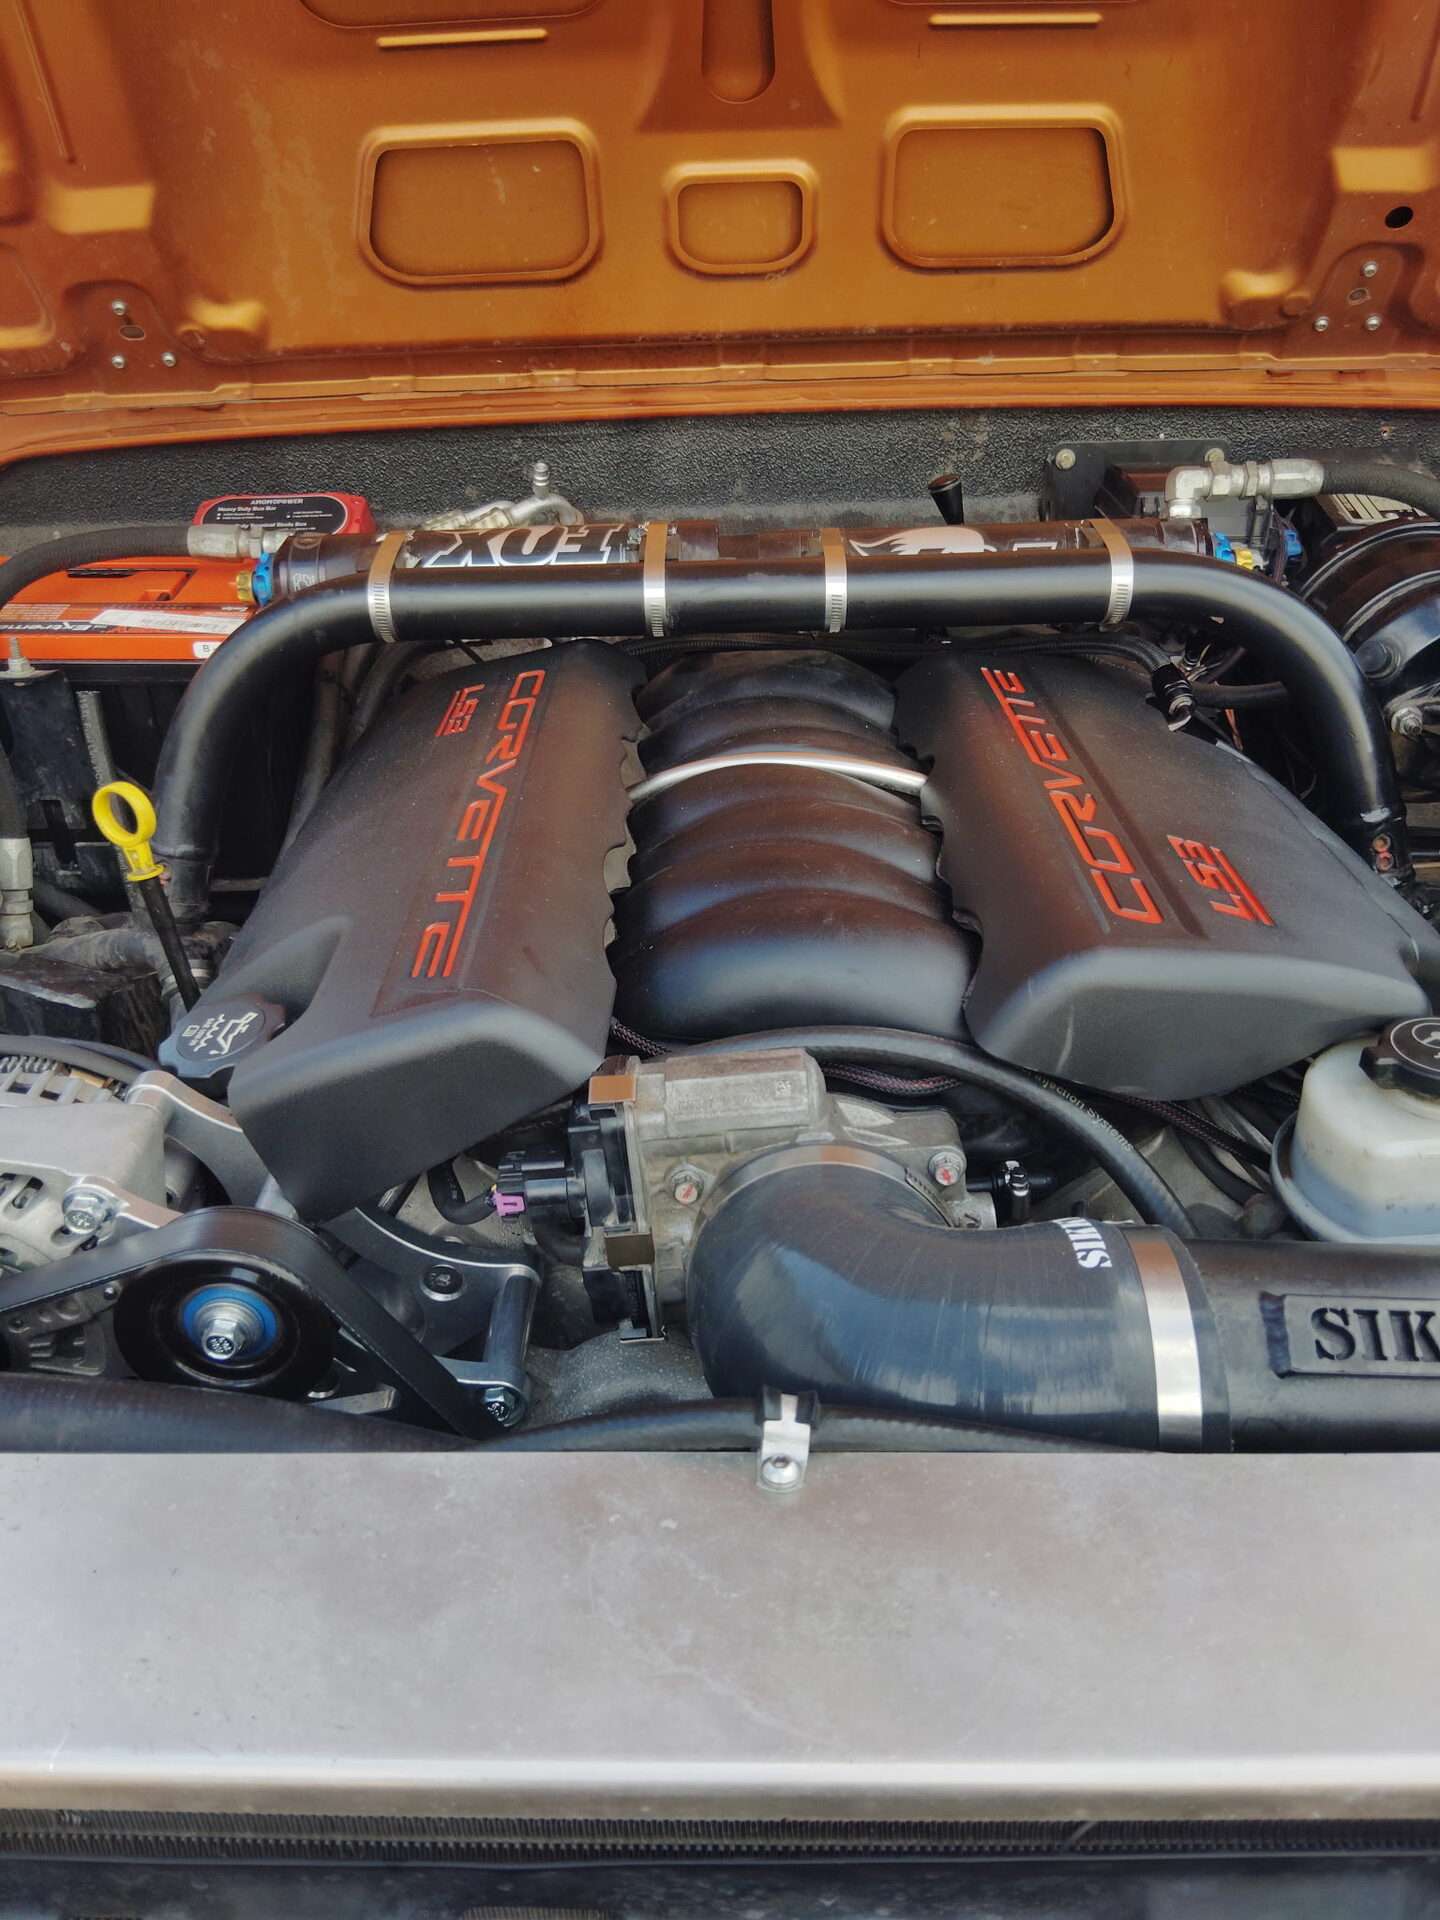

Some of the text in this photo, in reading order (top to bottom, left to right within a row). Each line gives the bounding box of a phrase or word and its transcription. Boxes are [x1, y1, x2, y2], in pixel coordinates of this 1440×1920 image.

[421, 523, 626, 568] FOX
[441, 684, 486, 736] LS3
[411, 669, 546, 978] CORVETTE
[981, 667, 1163, 924] CORVETTE
[1167, 834, 1257, 921] LS3
[1087, 1106, 1134, 1152] Systems
